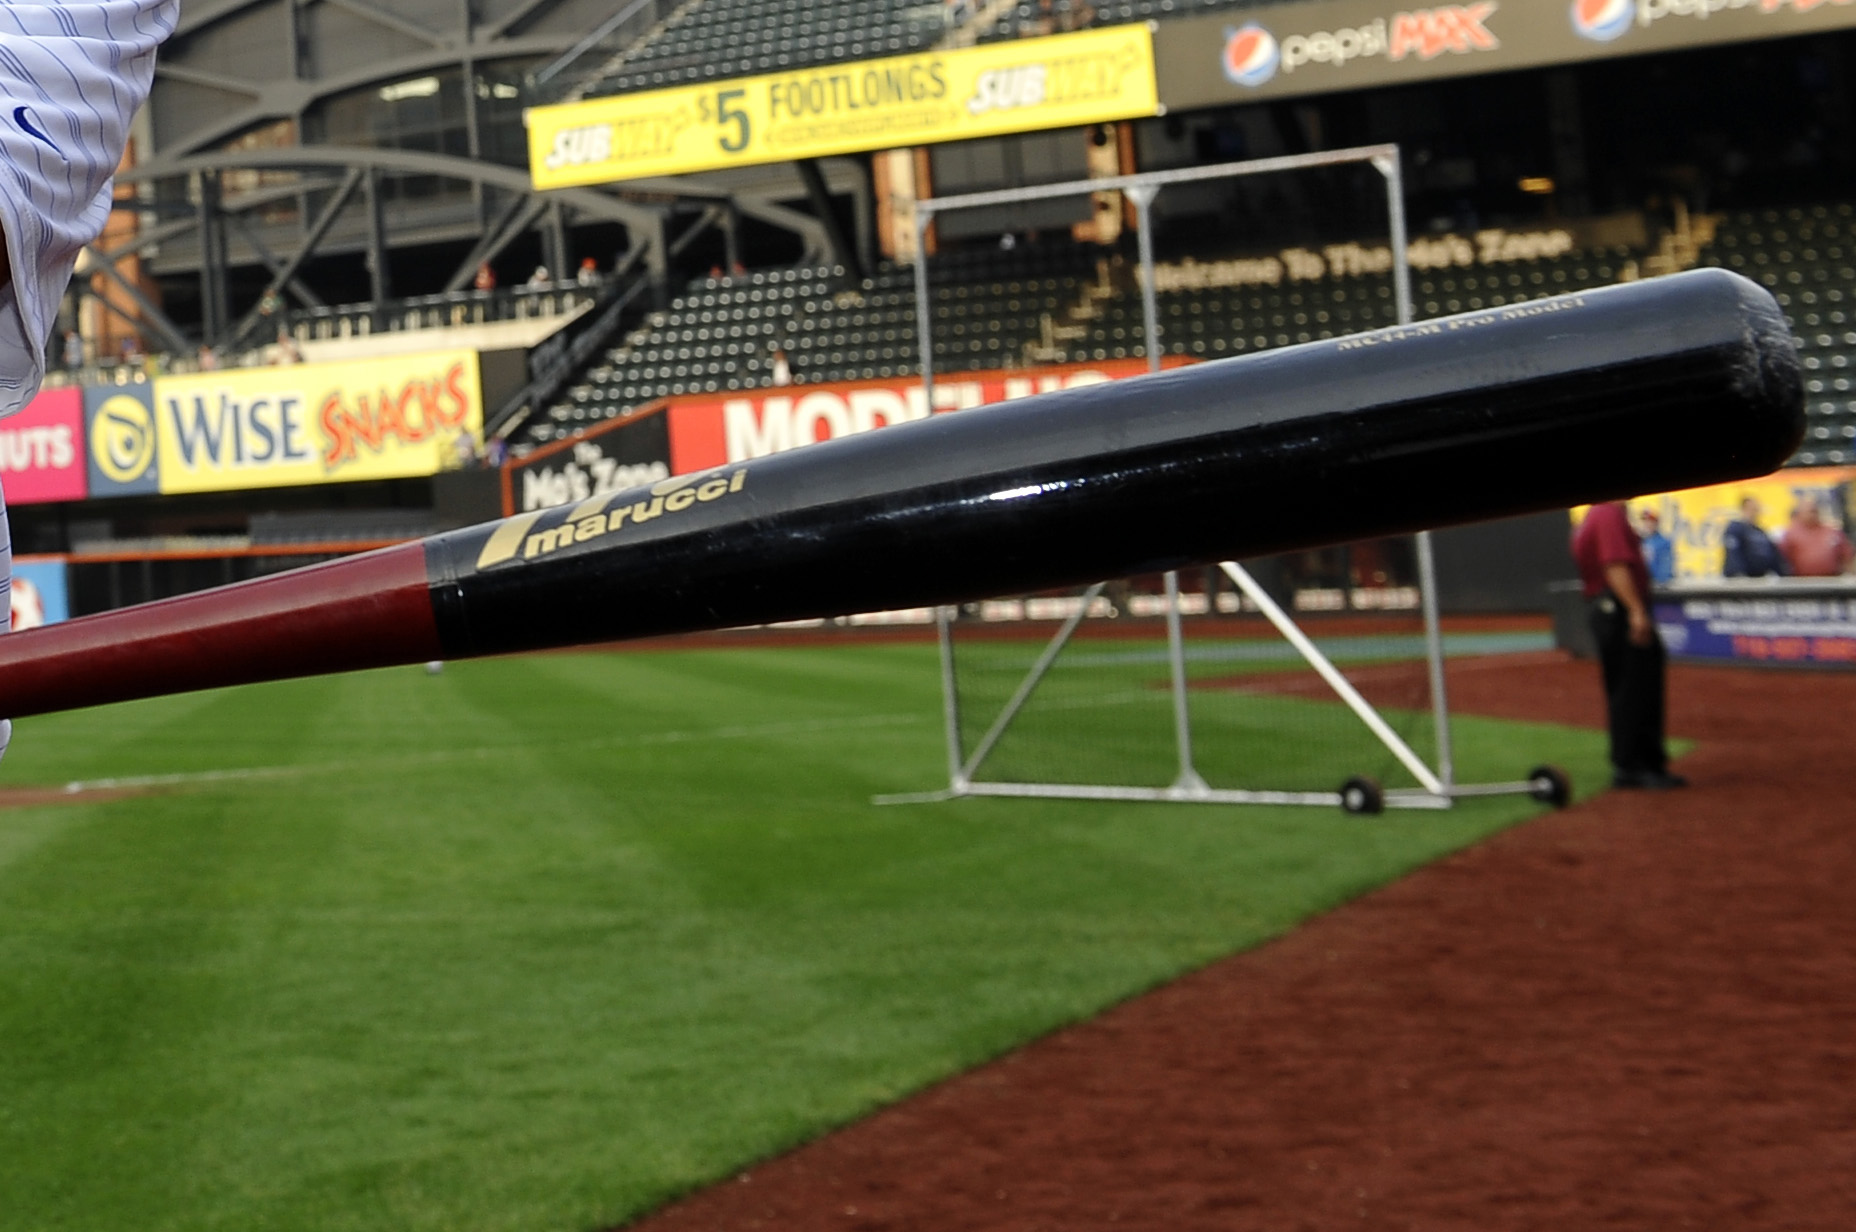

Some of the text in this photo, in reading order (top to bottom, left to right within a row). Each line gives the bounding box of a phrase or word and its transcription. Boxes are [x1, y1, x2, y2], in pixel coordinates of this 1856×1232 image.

[1280, 0, 1500, 74] pepsi MAX
[698, 88, 753, 154] $5
[768, 61, 946, 119] FOOTLONGS
[168, 364, 469, 468] WISE SNACKS
[522, 461, 591, 511] Mo's
[523, 469, 749, 560] marucci
